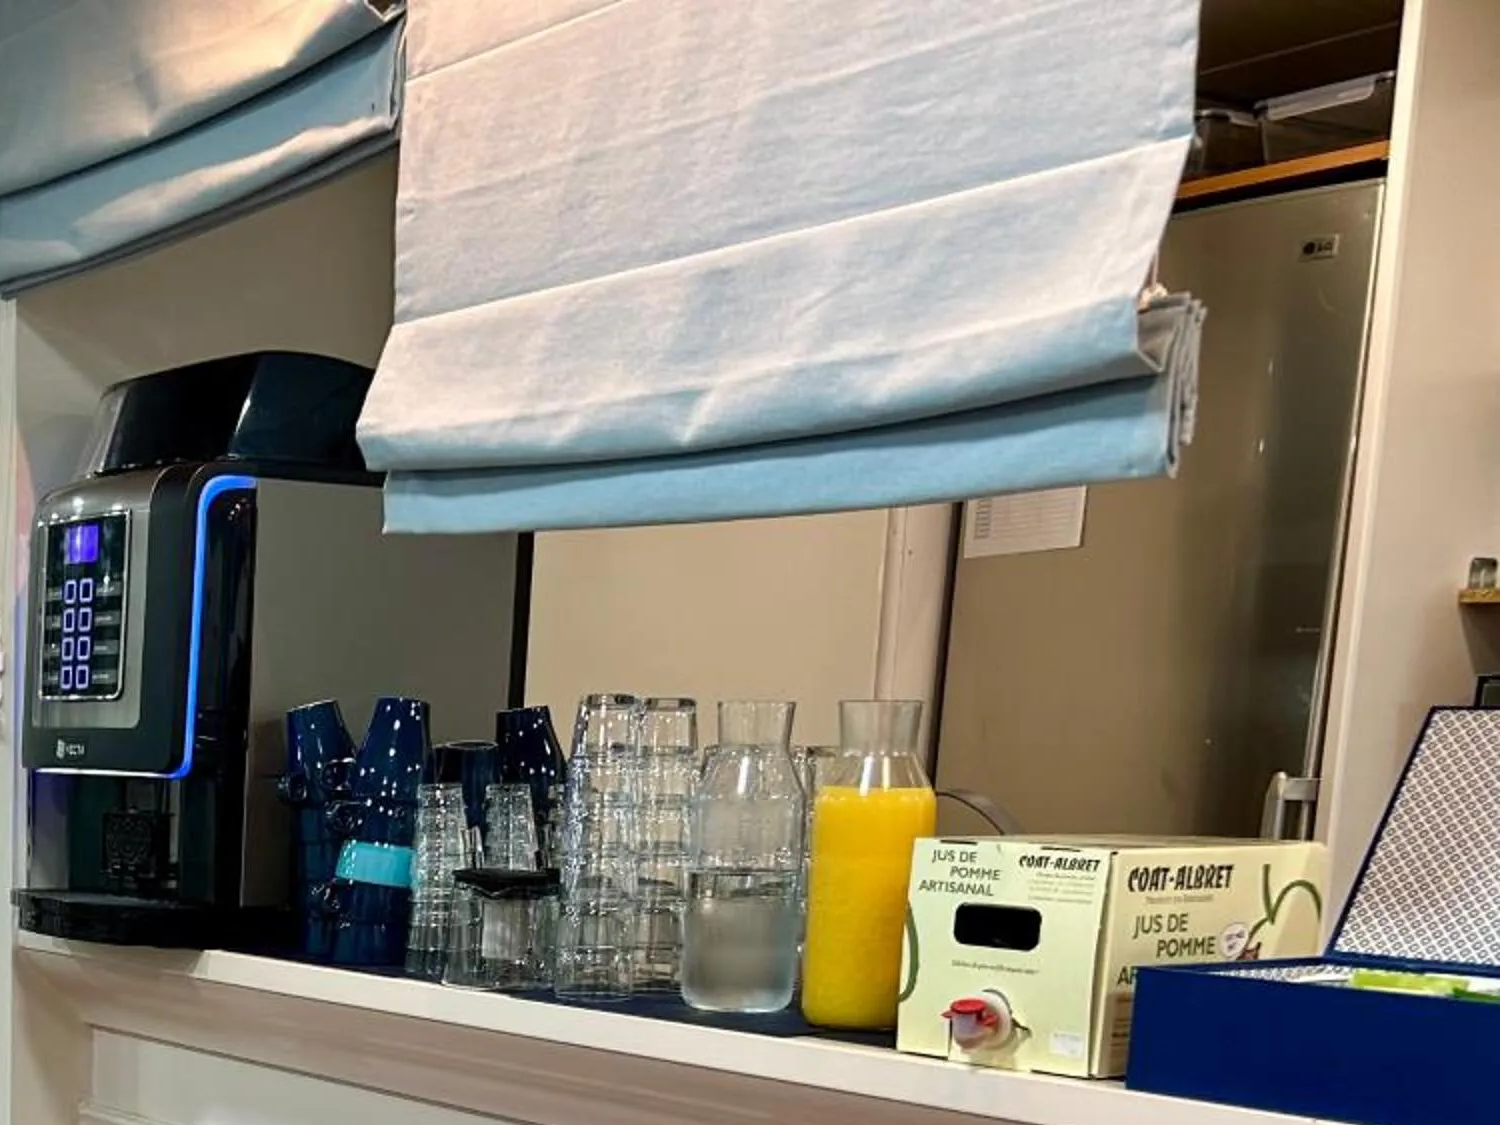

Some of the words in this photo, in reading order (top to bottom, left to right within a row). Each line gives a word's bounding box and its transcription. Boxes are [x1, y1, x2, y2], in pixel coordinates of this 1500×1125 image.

[932, 849, 956, 863] JUS
[959, 851, 977, 863] DE
[950, 865, 1001, 881] POMME
[918, 879, 995, 896] ARTISANAL
[1132, 914, 1163, 939] JUS
[1167, 913, 1189, 933] DE
[1156, 937, 1217, 958] POMME
